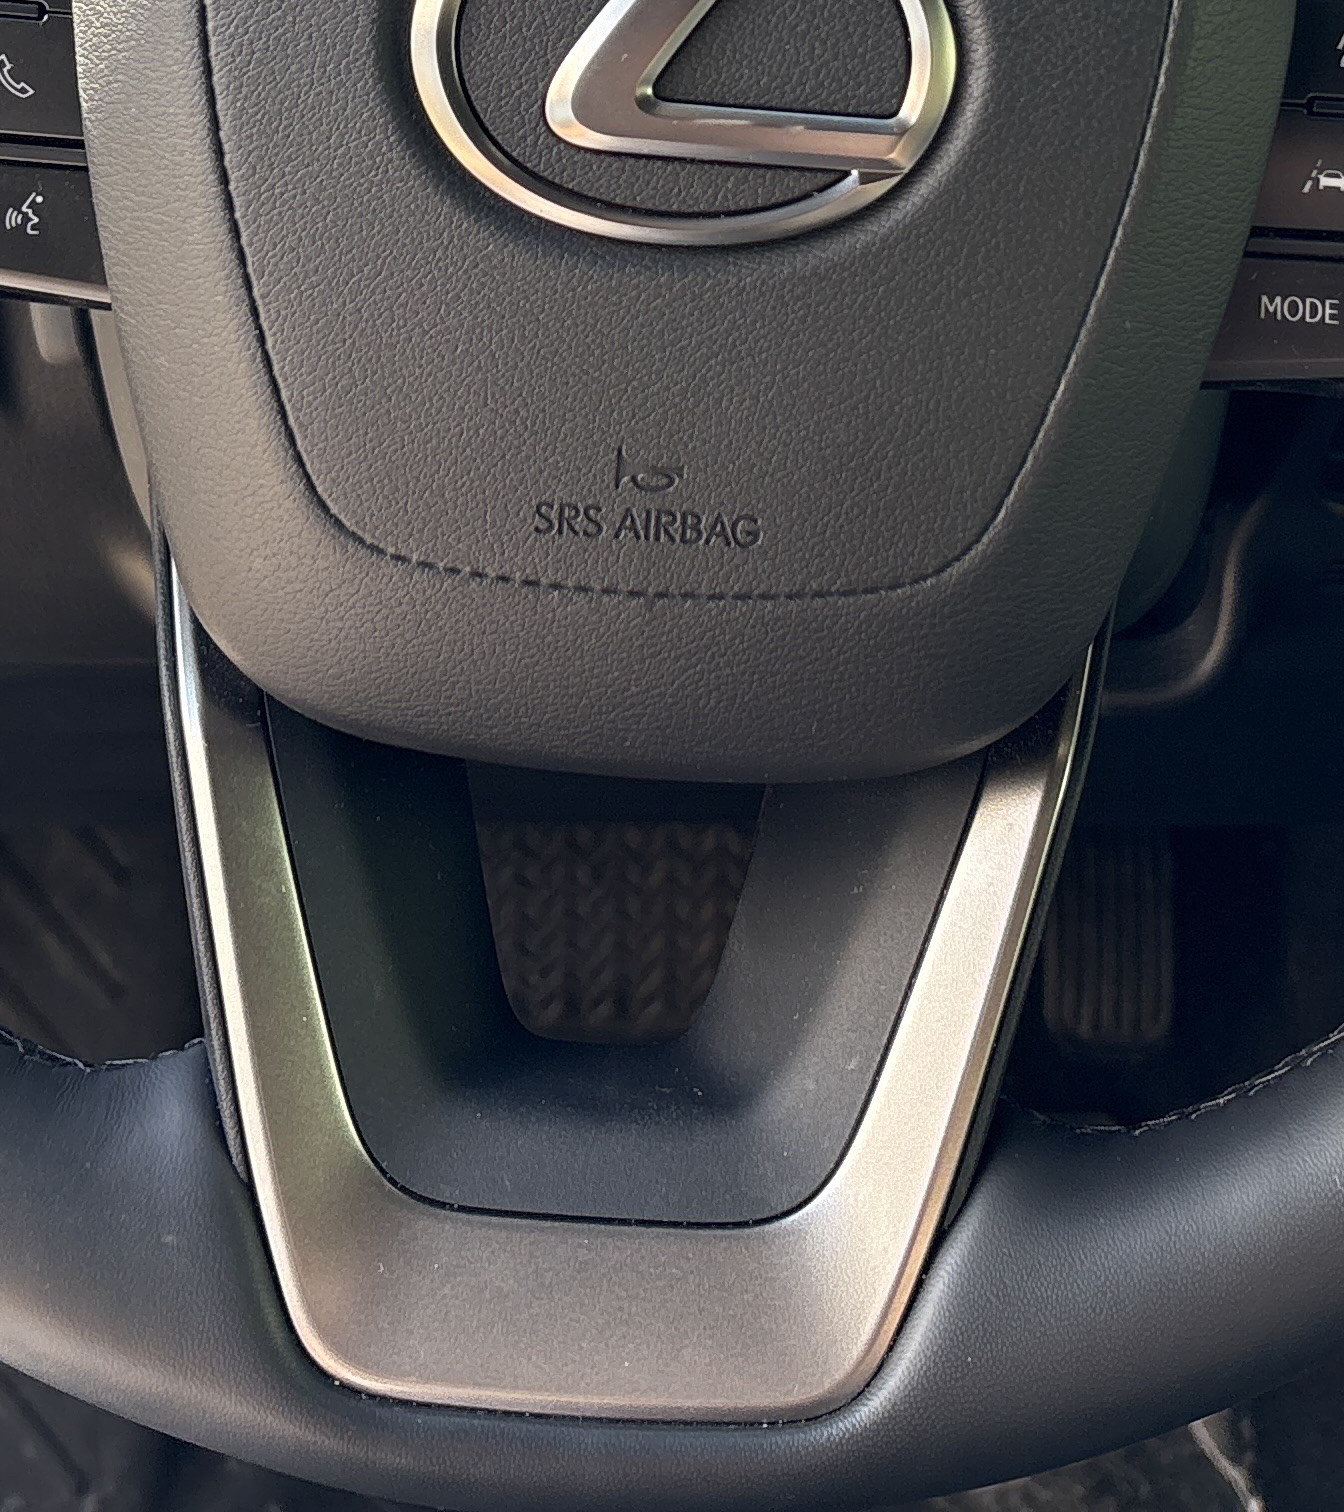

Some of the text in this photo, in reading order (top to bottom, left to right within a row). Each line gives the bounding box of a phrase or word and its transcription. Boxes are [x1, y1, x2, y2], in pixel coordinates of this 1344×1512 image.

[1259, 295, 1341, 326] MODE
[533, 501, 764, 550] SRS AIRBAG
